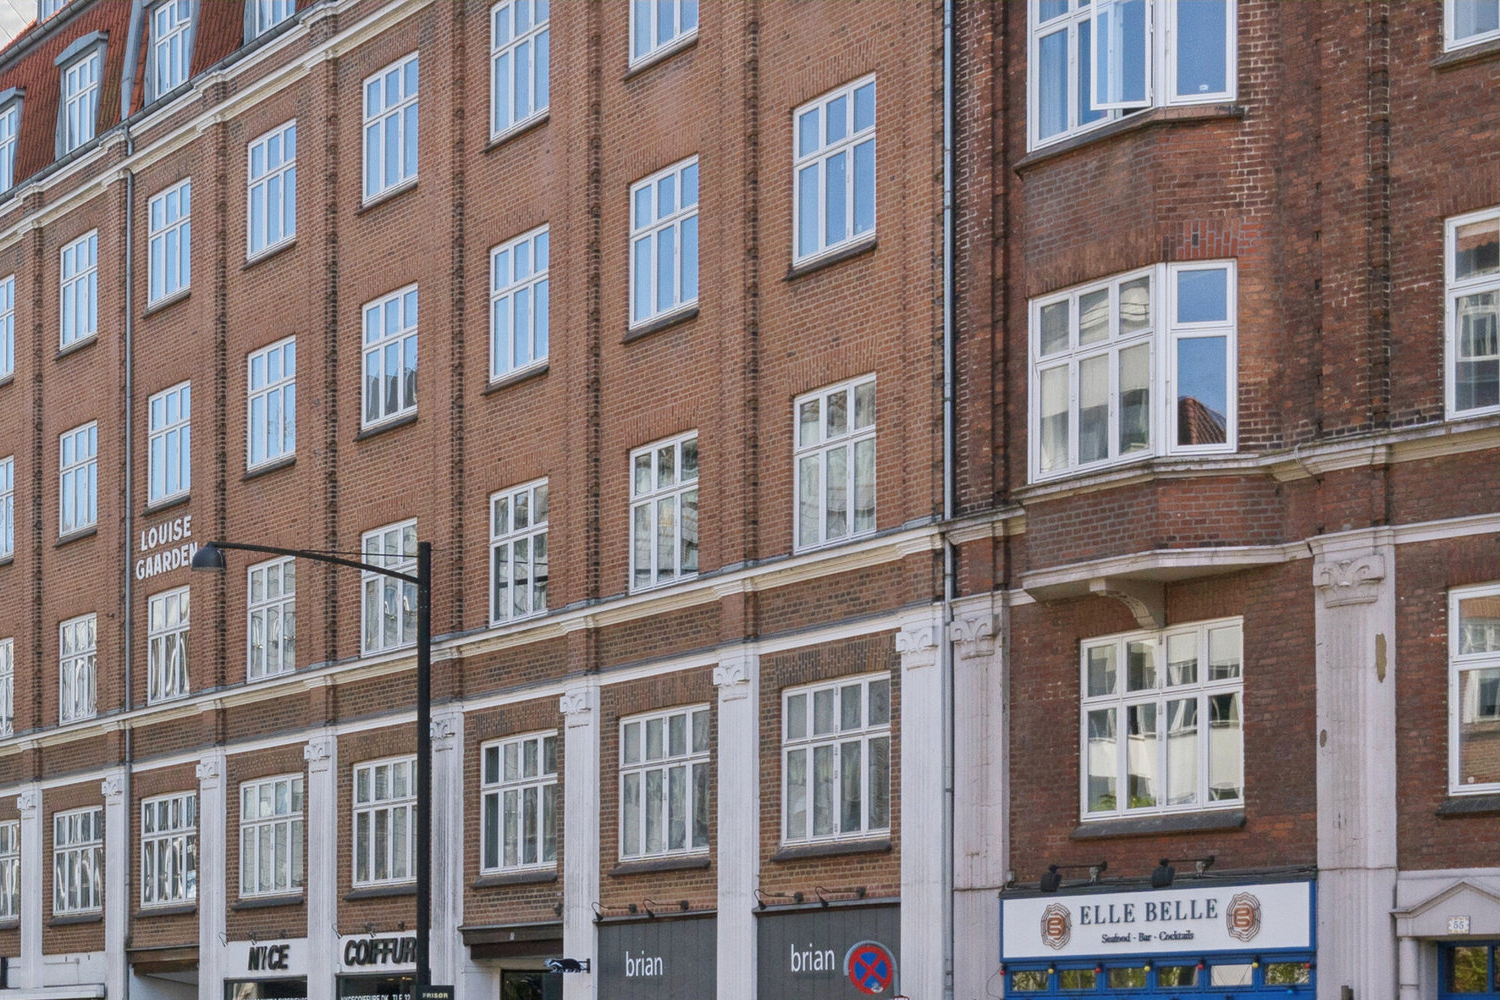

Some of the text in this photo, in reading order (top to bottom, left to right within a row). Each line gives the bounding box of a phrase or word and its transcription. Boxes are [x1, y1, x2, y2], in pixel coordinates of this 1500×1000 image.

[141, 515, 192, 552] LOUISE
[135, 541, 198, 580] GAARDEN
[1079, 898, 1219, 926] ELLE BELLE
[1453, 921, 1464, 930] 55
[1101, 930, 1194, 944] Seafood Bar Cocktails
[248, 944, 290, 971] NYCE
[344, 937, 418, 966] COIFFUR
[625, 951, 663, 977] brian
[790, 943, 835, 972] brian
